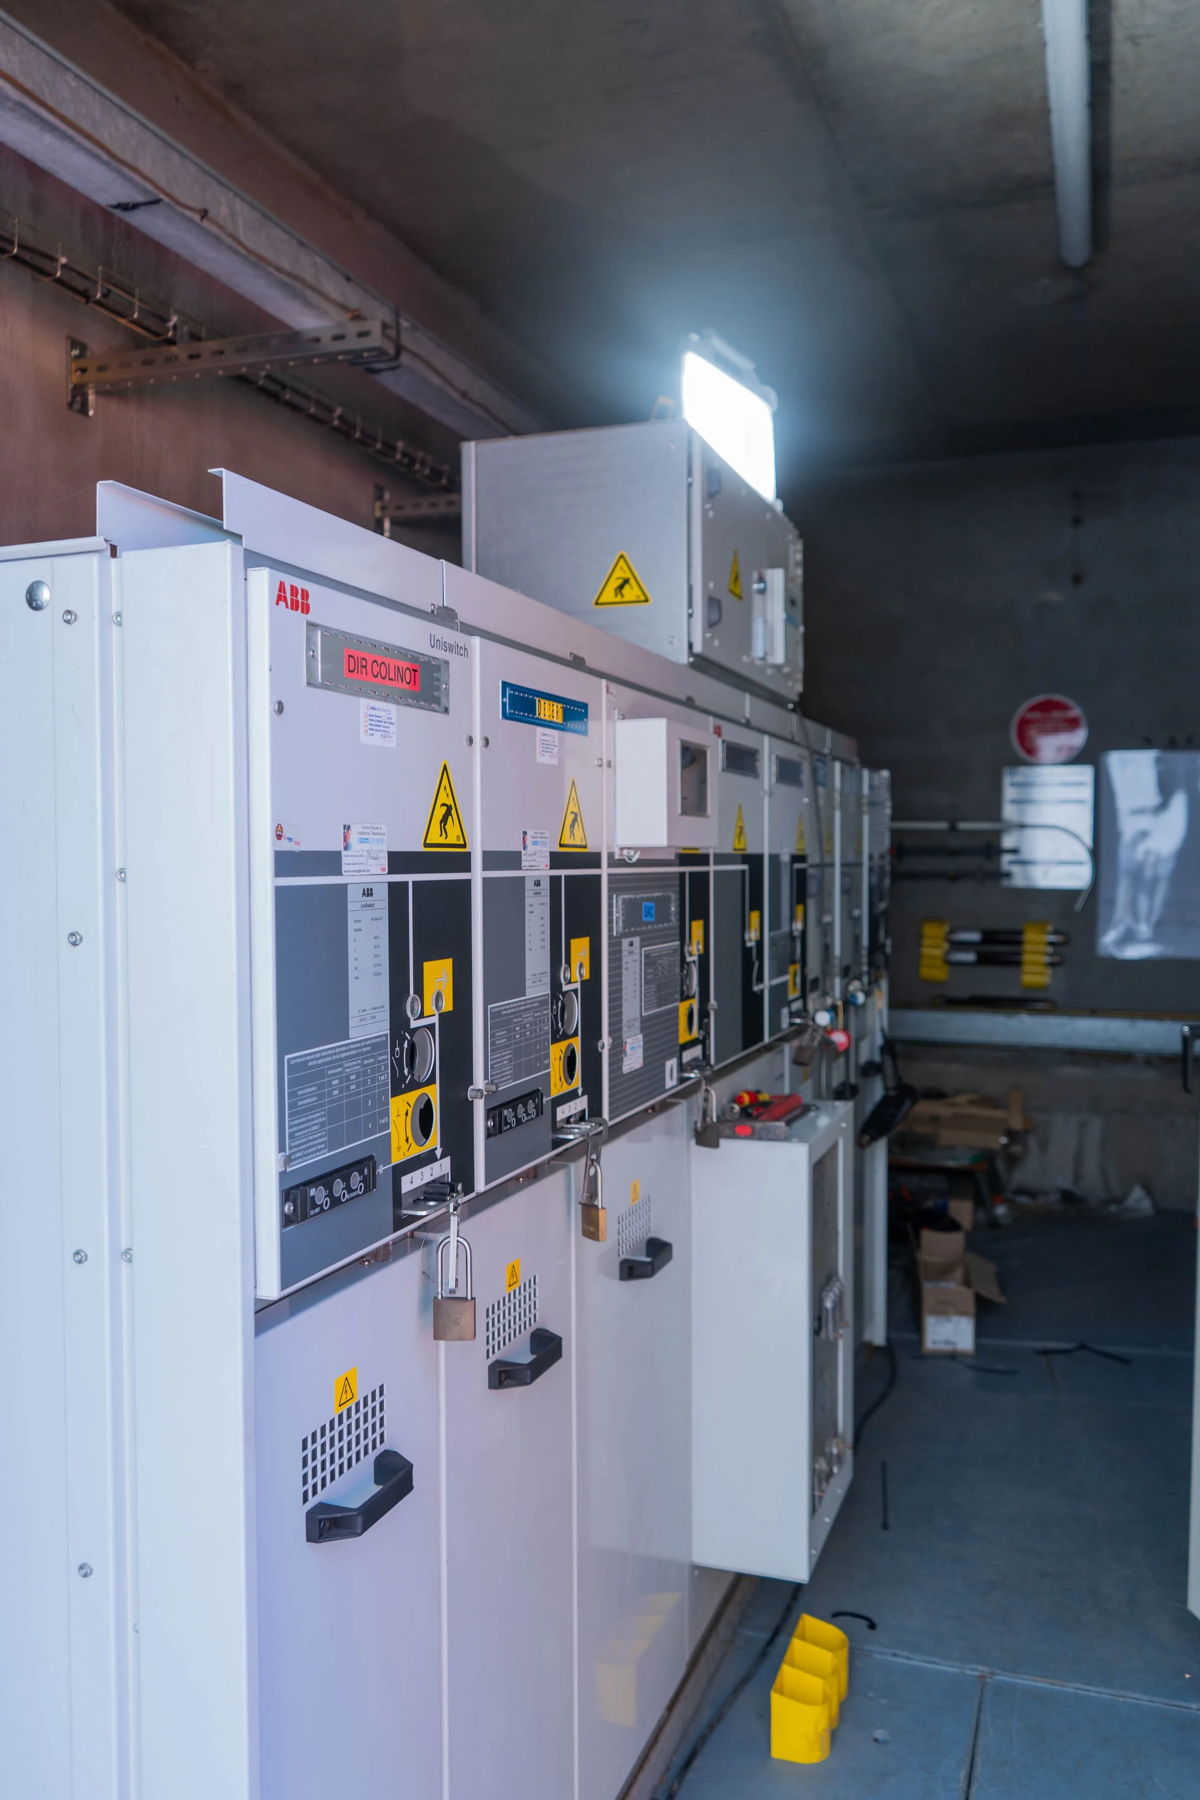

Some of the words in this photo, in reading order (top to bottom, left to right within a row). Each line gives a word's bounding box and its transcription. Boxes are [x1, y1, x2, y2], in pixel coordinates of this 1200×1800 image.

[275, 580, 311, 615] ABB
[429, 633, 469, 659] Uniswitch
[347, 654, 368, 677] DIR
[371, 659, 418, 687] COLINOT
[361, 887, 374, 898] ABB
[409, 1175, 414, 1184] 4
[420, 1171, 424, 1181] 3
[430, 1166, 434, 1176] 2
